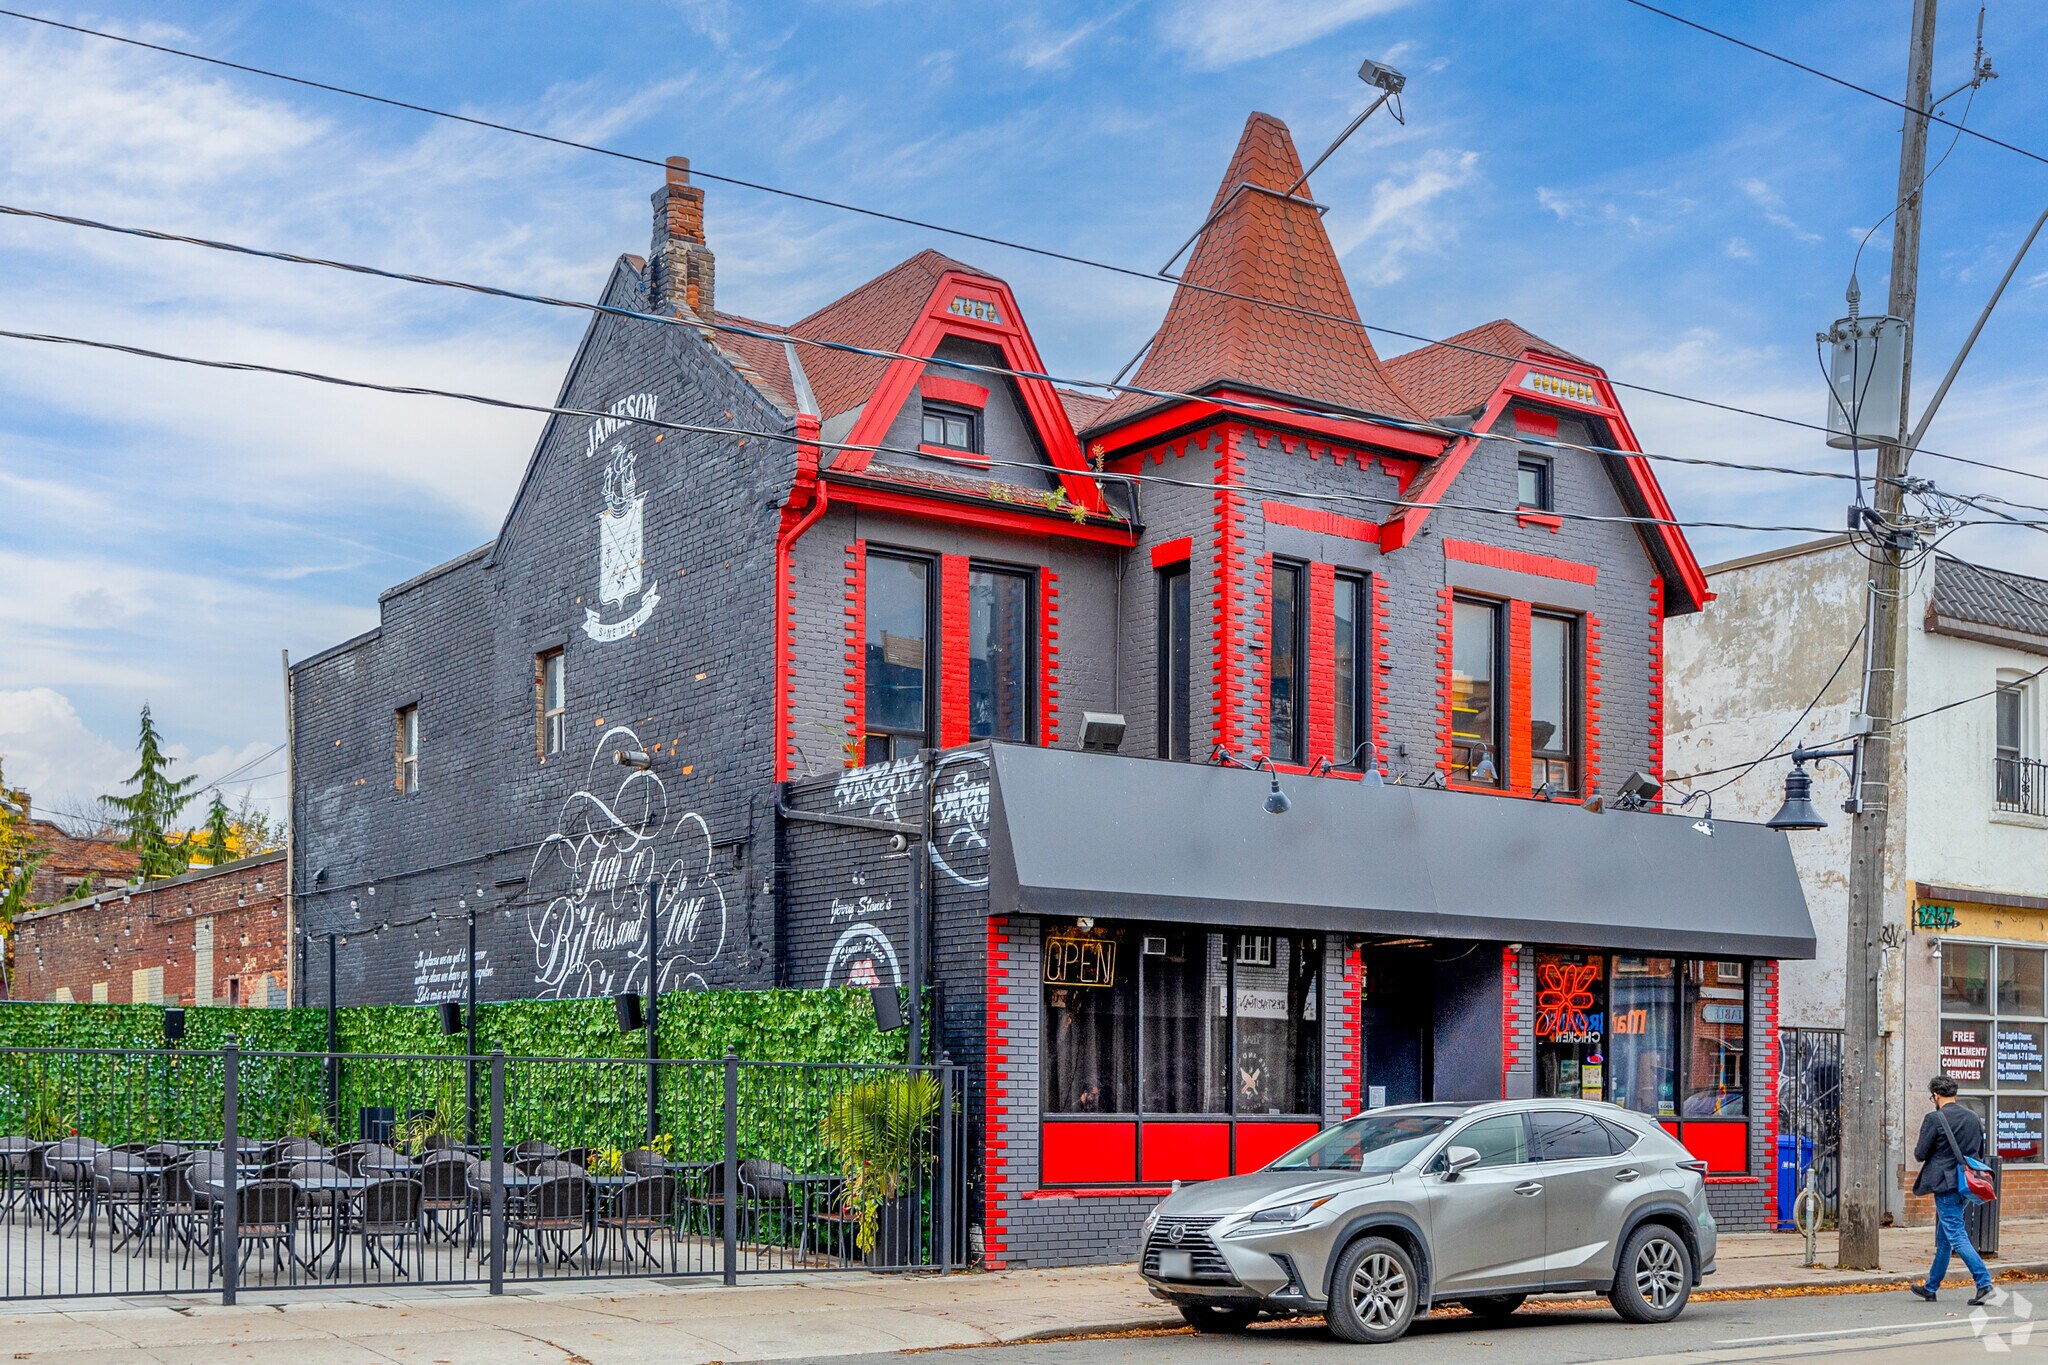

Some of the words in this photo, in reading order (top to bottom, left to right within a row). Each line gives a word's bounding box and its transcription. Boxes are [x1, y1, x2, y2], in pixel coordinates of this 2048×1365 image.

[586, 393, 659, 458] JAMESON
[598, 626, 616, 639] SINE
[1046, 941, 1112, 984] OPEN
[1952, 1030, 1975, 1042] FREE
[1939, 1046, 1987, 1056] SETTLEMENT/
[1941, 1058, 1985, 1068] COMMUNITY
[1946, 1070, 1981, 1080] SERVICES
